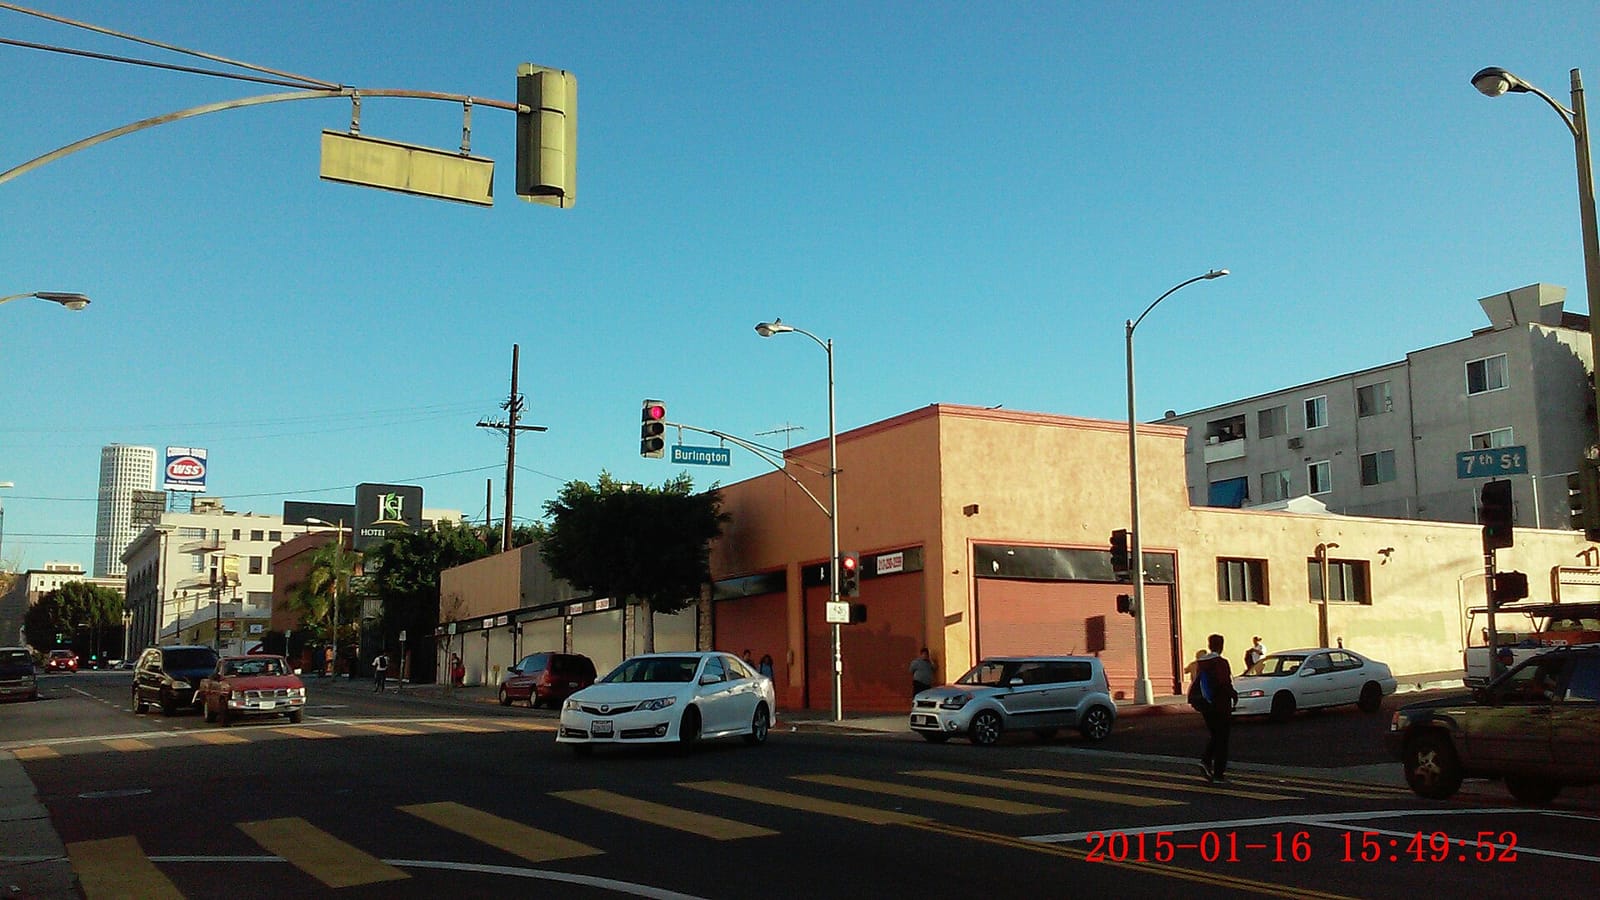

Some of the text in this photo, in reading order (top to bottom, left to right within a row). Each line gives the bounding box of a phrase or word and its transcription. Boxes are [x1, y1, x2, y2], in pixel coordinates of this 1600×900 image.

[675, 450, 727, 464] Burlington
[1462, 454, 1520, 473] 7th St
[172, 464, 200, 476] WSS
